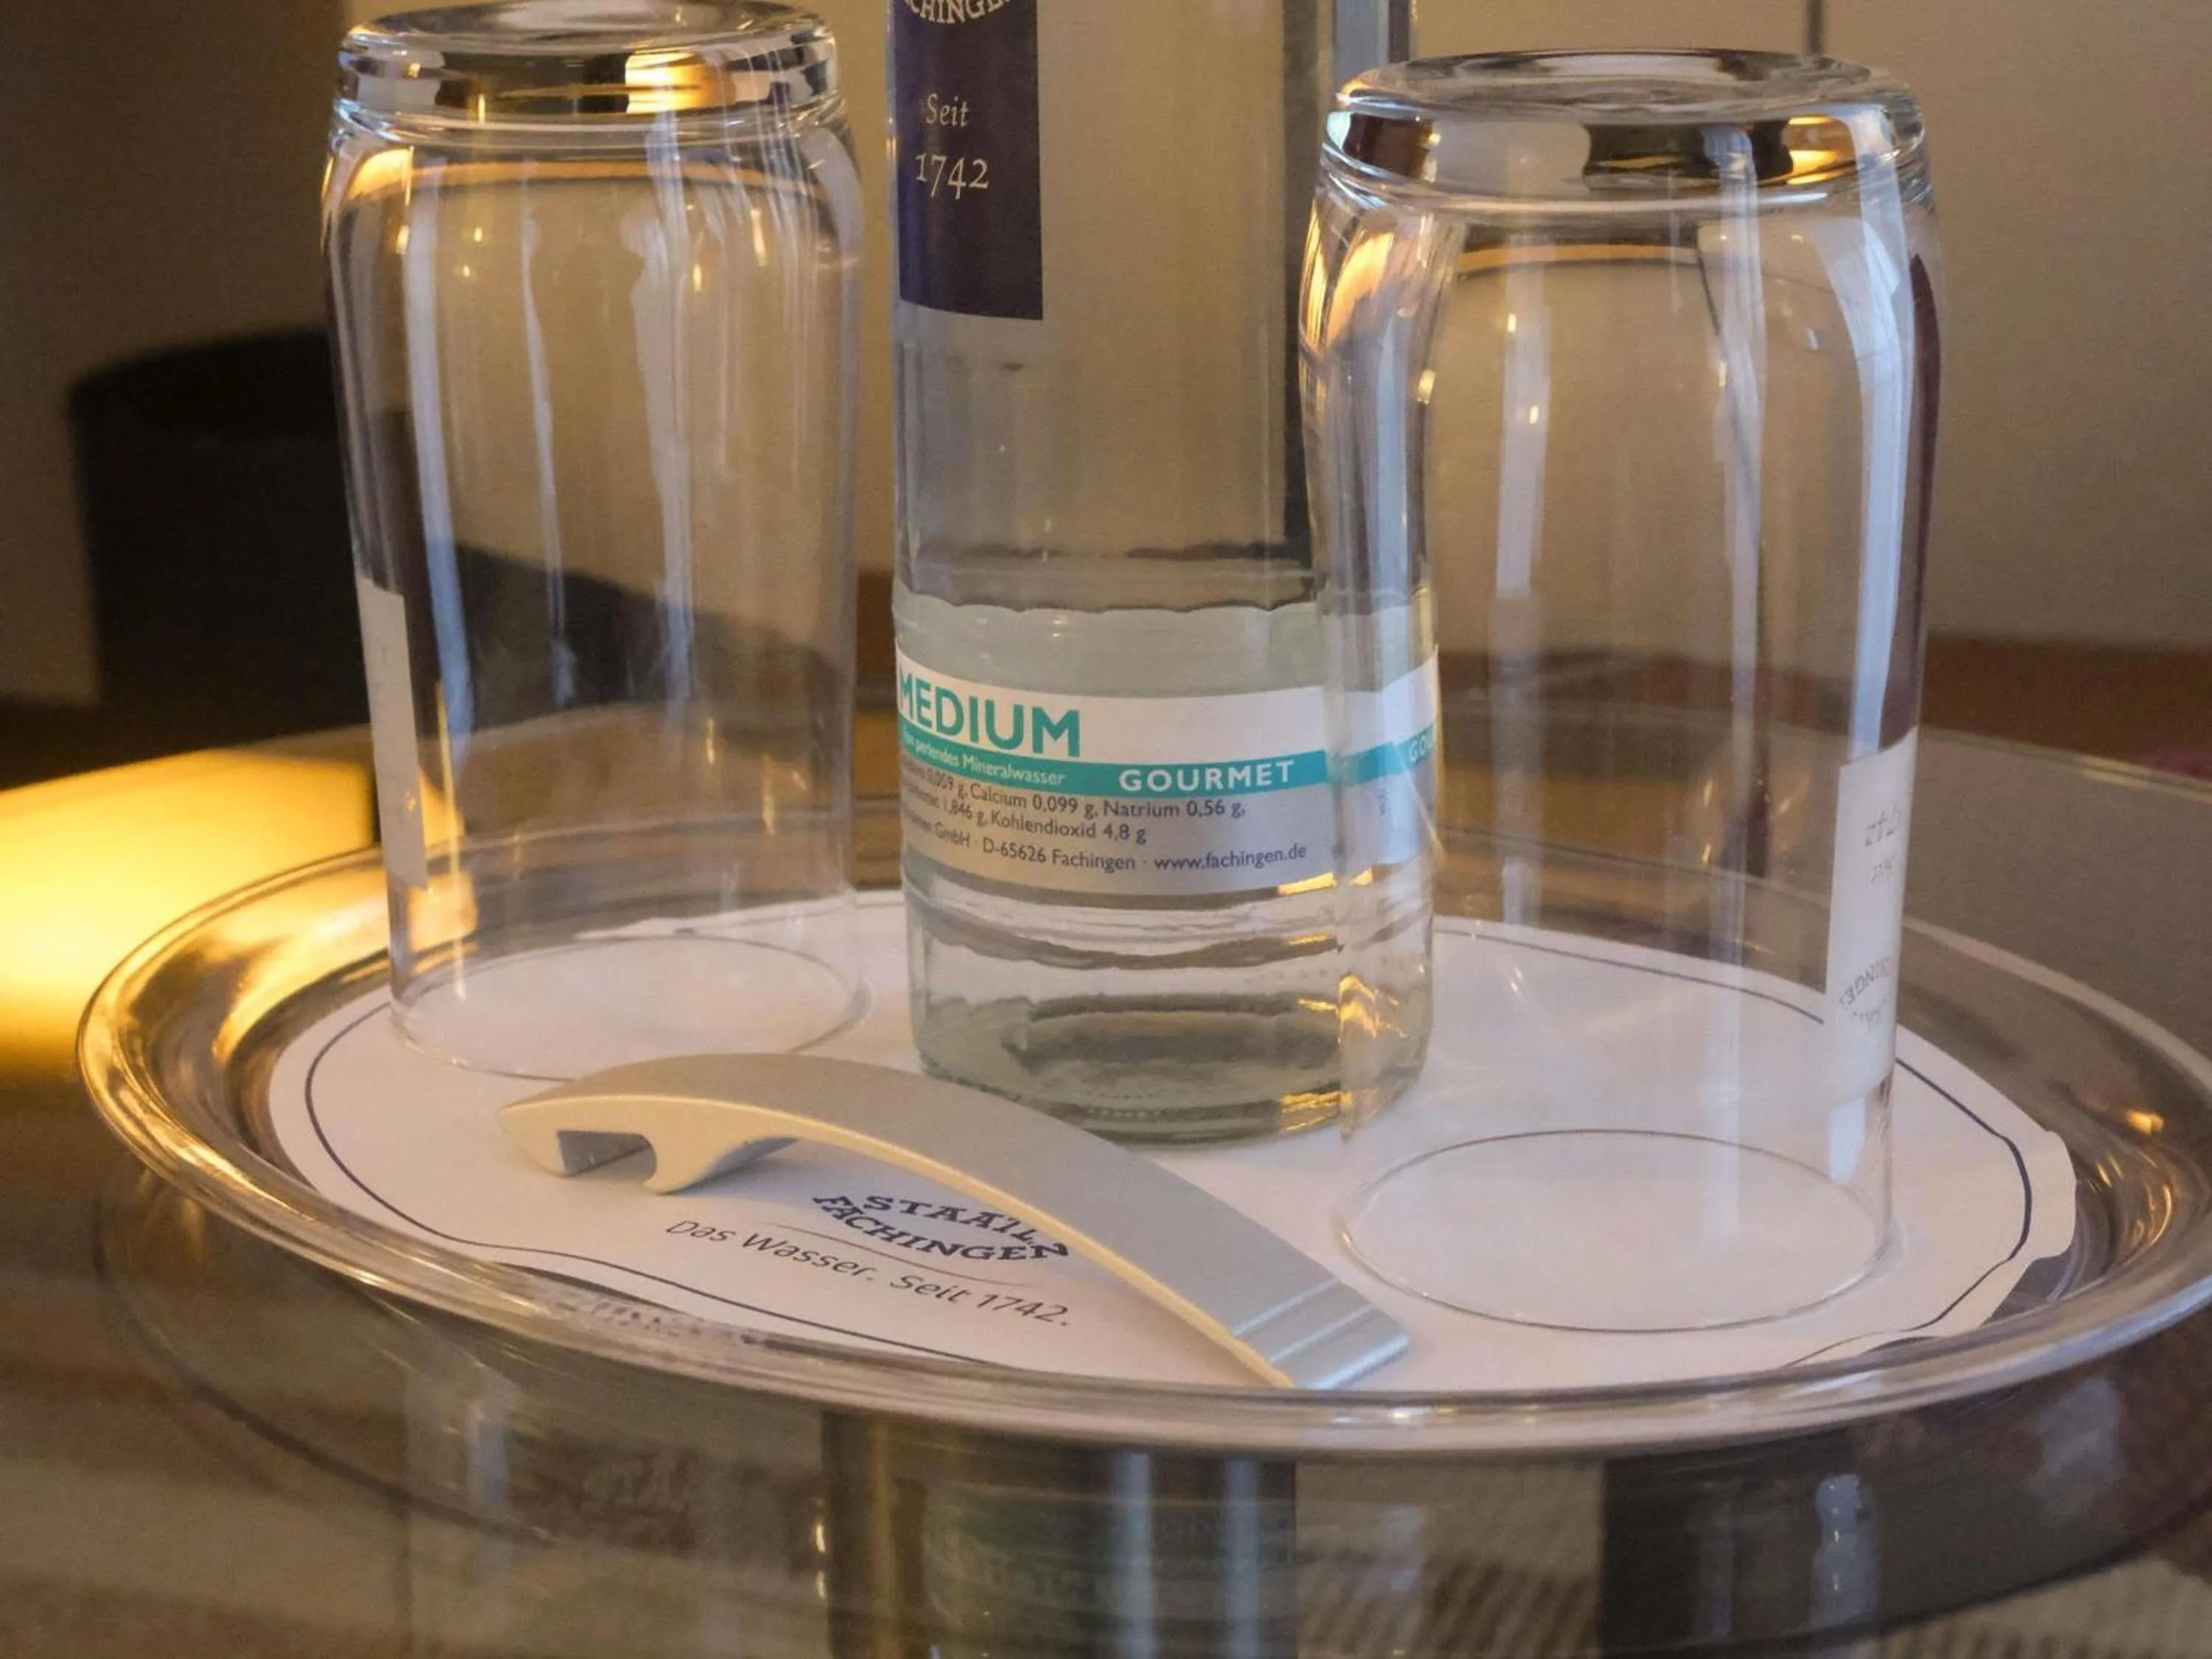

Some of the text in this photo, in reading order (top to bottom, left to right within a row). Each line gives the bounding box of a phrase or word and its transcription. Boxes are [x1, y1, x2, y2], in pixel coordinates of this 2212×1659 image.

[926, 93, 969, 127] Seit
[915, 153, 990, 200] 1742
[899, 672, 1080, 757] MEDIUM
[962, 753, 1066, 786] Mineralwasser
[1119, 760, 1294, 792] GOURMET
[970, 782, 1027, 808] Calcium
[1032, 793, 1078, 813] 0,099
[1103, 800, 1180, 818] Natrium
[1186, 799, 1225, 818] 0,56
[933, 821, 1307, 874] GmbH D-65626 Fachingen www.fachingen.de
[991, 809, 1096, 838] Kohlendioxid
[1102, 823, 1130, 842] 4,8
[1135, 827, 1147, 845] g
[813, 1196, 1070, 1261] FACHINGEN
[666, 1220, 1069, 1326] Das Wasser. Seit 1742.
